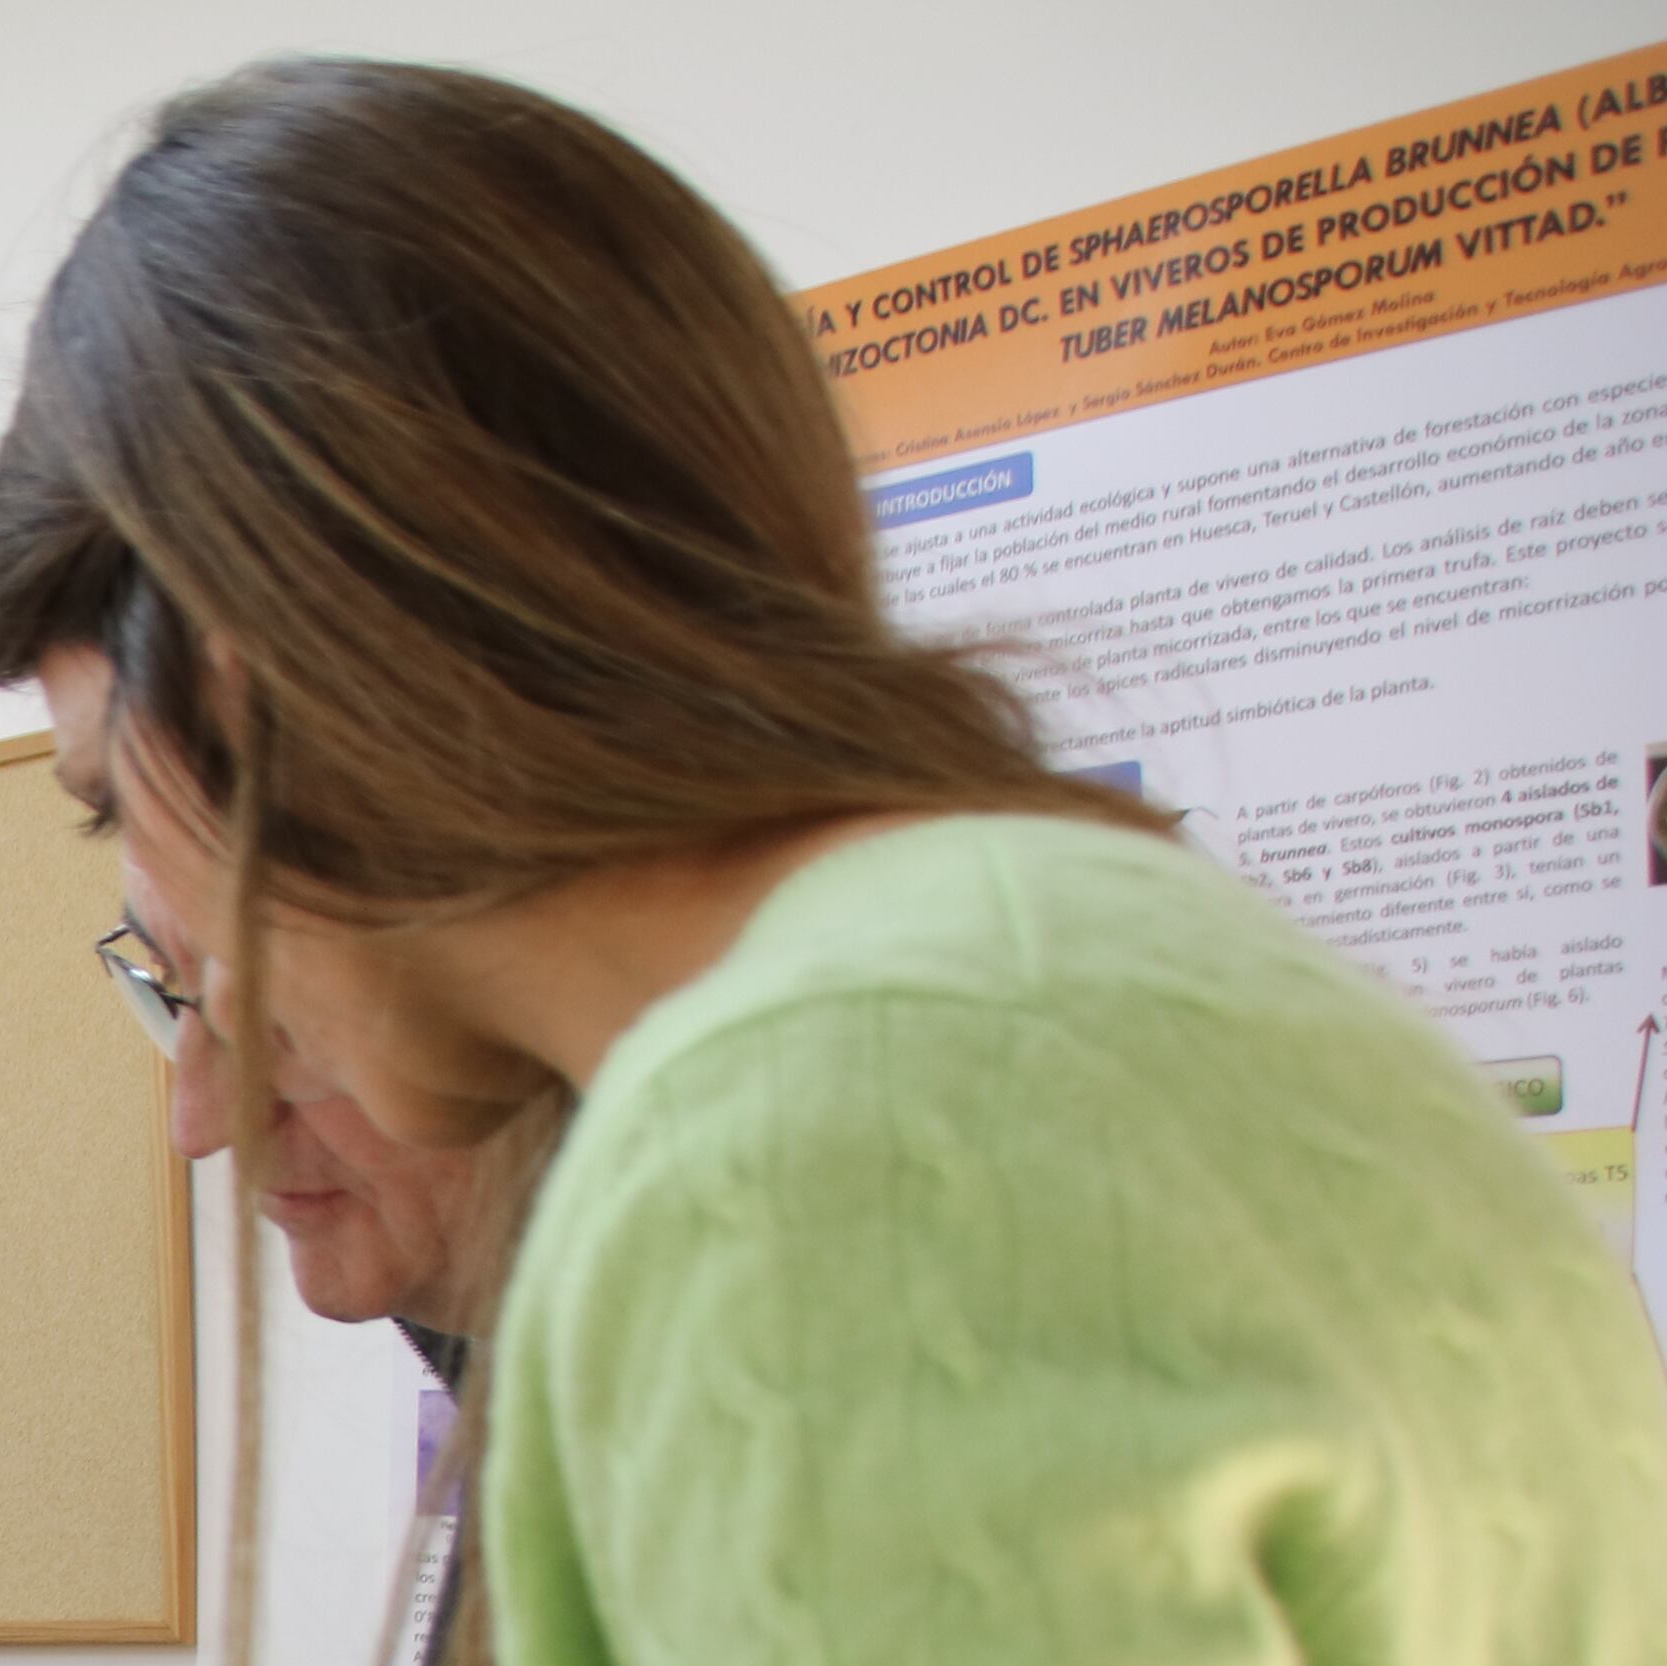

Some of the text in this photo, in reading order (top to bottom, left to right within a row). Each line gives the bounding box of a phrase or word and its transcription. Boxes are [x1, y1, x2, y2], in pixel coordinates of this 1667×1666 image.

[845, 299, 861, 327] Y
[872, 259, 1012, 320] CONTROL
[1021, 243, 1059, 279] DE
[1069, 156, 1372, 265] SPHAEROSPORELLA
[1385, 104, 1561, 178] BRUNNEA
[998, 296, 1048, 333] DC.
[1059, 280, 1099, 316] EN
[1109, 238, 1250, 300] VIVEROS
[1261, 223, 1304, 261] DE
[1316, 151, 1575, 246] PRODUCCIÓN
[1590, 133, 1641, 175] DE
[1060, 315, 1147, 362] TUBER
[1156, 238, 1442, 337] MELANOSPORUM
[875, 469, 1013, 518] INTRODUCCIÓN
[904, 534, 948, 557] ajusta
[969, 522, 997, 540] una
[1003, 500, 1073, 532] actividad
[1079, 486, 1155, 514] ecológica
[1177, 468, 1240, 492] supone
[1247, 458, 1280, 477] una
[1287, 436, 1386, 468] alternativa
[1424, 402, 1534, 438] forestación
[1542, 393, 1580, 413] con
[904, 436, 1645, 606] las cuales 80 % encuentran Huesca, Teruel Castellón, aumentando año
[939, 553, 969, 573] fijar
[992, 530, 1069, 563] población
[1074, 521, 1098, 541] del
[1105, 511, 1156, 534] medio
[1162, 498, 1201, 522] rural
[1207, 476, 1316, 512] fomentando
[1345, 450, 1440, 483] desarrollo
[1446, 427, 1556, 461] económico
[1128, 615, 1174, 636] hasta
[1181, 607, 1213, 627] que
[1220, 584, 1330, 617] obtengamos
[1362, 564, 1435, 594] primera
[1444, 551, 1495, 574] trufa.
[1506, 543, 1547, 563] Este
[1556, 524, 1648, 557] proyecto
[1130, 587, 1181, 612] planta
[1215, 569, 1269, 591] vivero
[1304, 545, 1373, 574] calidad.
[1382, 540, 1413, 559] Los
[1419, 524, 1490, 551] análisis
[1530, 508, 1565, 529] raíz
[1573, 497, 1639, 521] deben
[1096, 645, 1149, 671] planta
[1152, 624, 1257, 656] micorrizada,
[1262, 615, 1310, 636] entre
[1315, 609, 1341, 626] los
[1346, 603, 1381, 623] que
[1412, 576, 1528, 608] encuentran:
[1154, 654, 1247, 683] radiculares
[1253, 628, 1381, 664] disminuyendo
[1413, 611, 1459, 635] nivel
[1498, 583, 1635, 620] micorrización
[1159, 677, 1434, 736] aptitud simbiótica planta.
